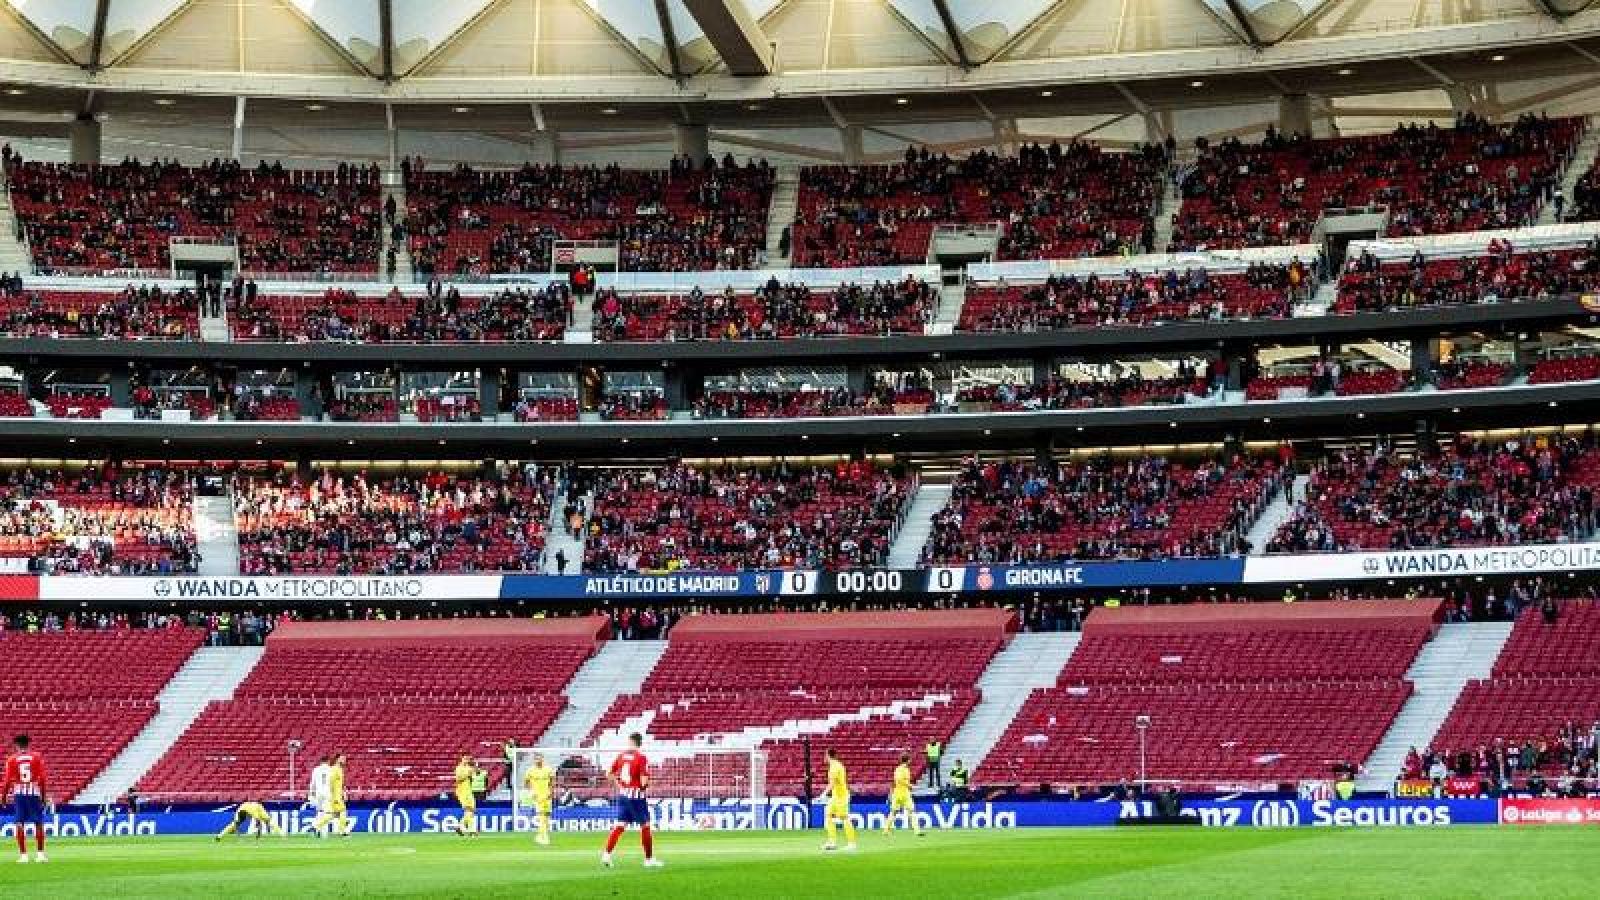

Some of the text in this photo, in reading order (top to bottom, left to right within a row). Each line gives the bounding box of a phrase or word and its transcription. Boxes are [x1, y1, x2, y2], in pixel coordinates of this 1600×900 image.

[1386, 553, 1469, 574] WANDA
[585, 573, 739, 594] ATLÉTICO DE MADRID
[791, 573, 807, 593] 0
[836, 571, 902, 593] 00:00
[939, 569, 953, 589] 0
[1005, 567, 1084, 586] GIRONA FC
[177, 579, 422, 598] WANDA METROPOLITANO
[421, 808, 541, 833] Seuros
[823, 802, 1016, 829] ondoVida
[1311, 801, 1450, 826] Seguros
